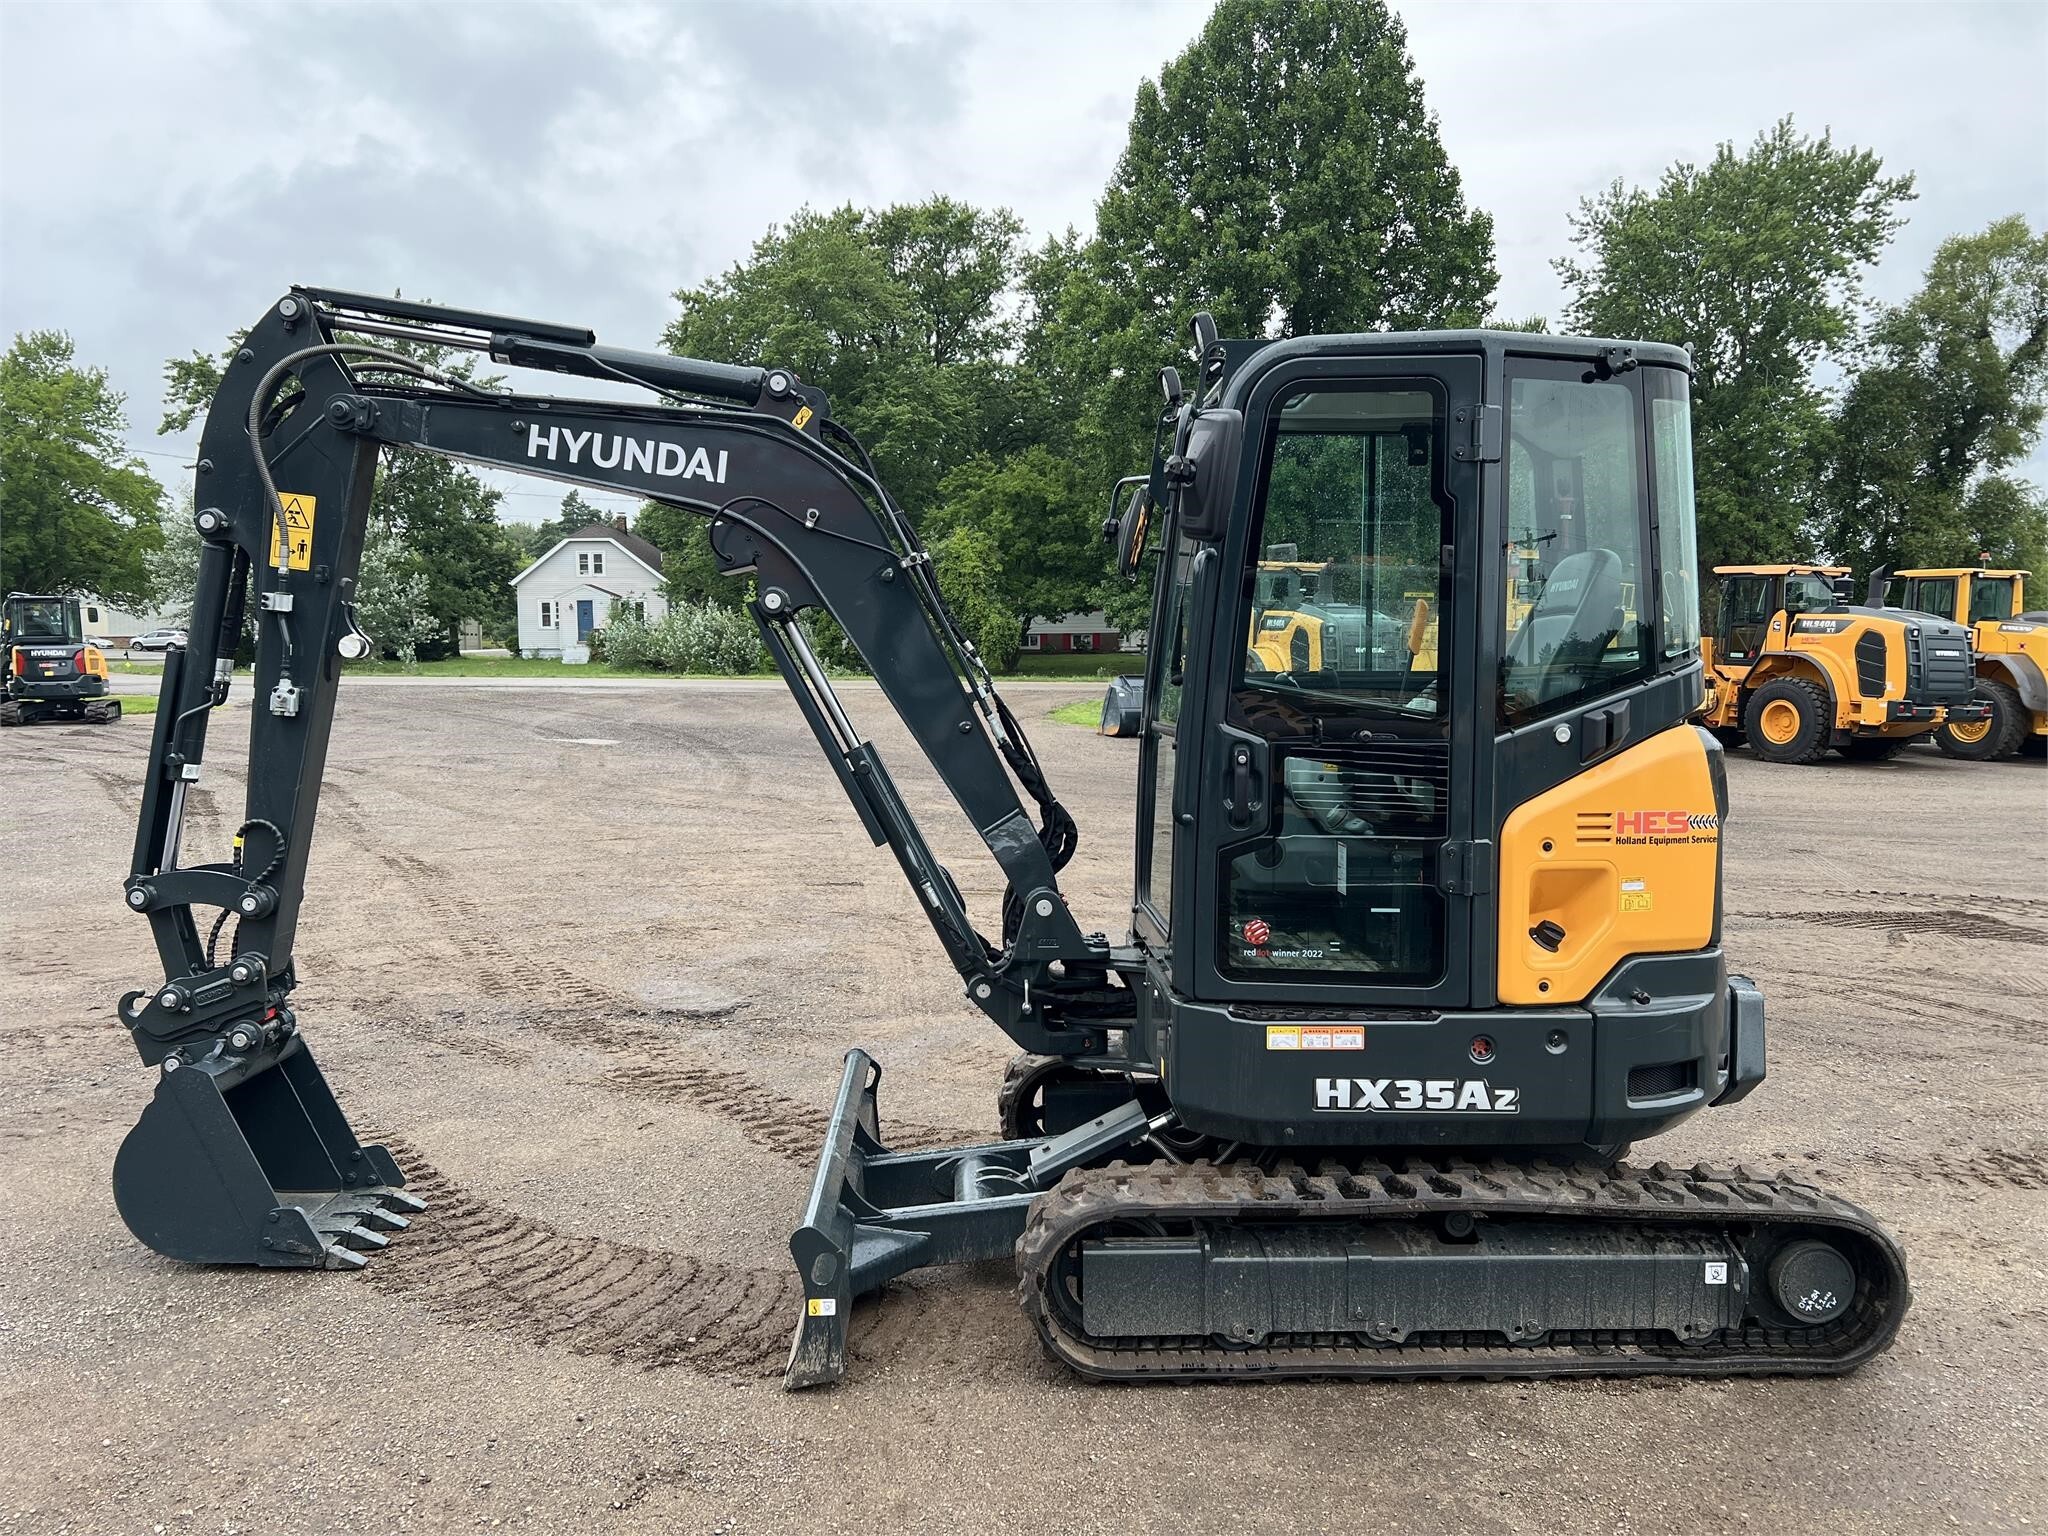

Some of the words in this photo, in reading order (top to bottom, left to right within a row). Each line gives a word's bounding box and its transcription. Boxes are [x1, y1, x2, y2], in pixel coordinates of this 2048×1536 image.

[527, 424, 728, 484] HYUNDAI
[1802, 620, 1836, 628] HL940A
[1616, 811, 1689, 834] HES
[1615, 836, 1647, 845] Holland
[1649, 836, 1690, 846] Equipment
[1272, 948, 1300, 958] winner
[1302, 949, 1323, 958] 2022
